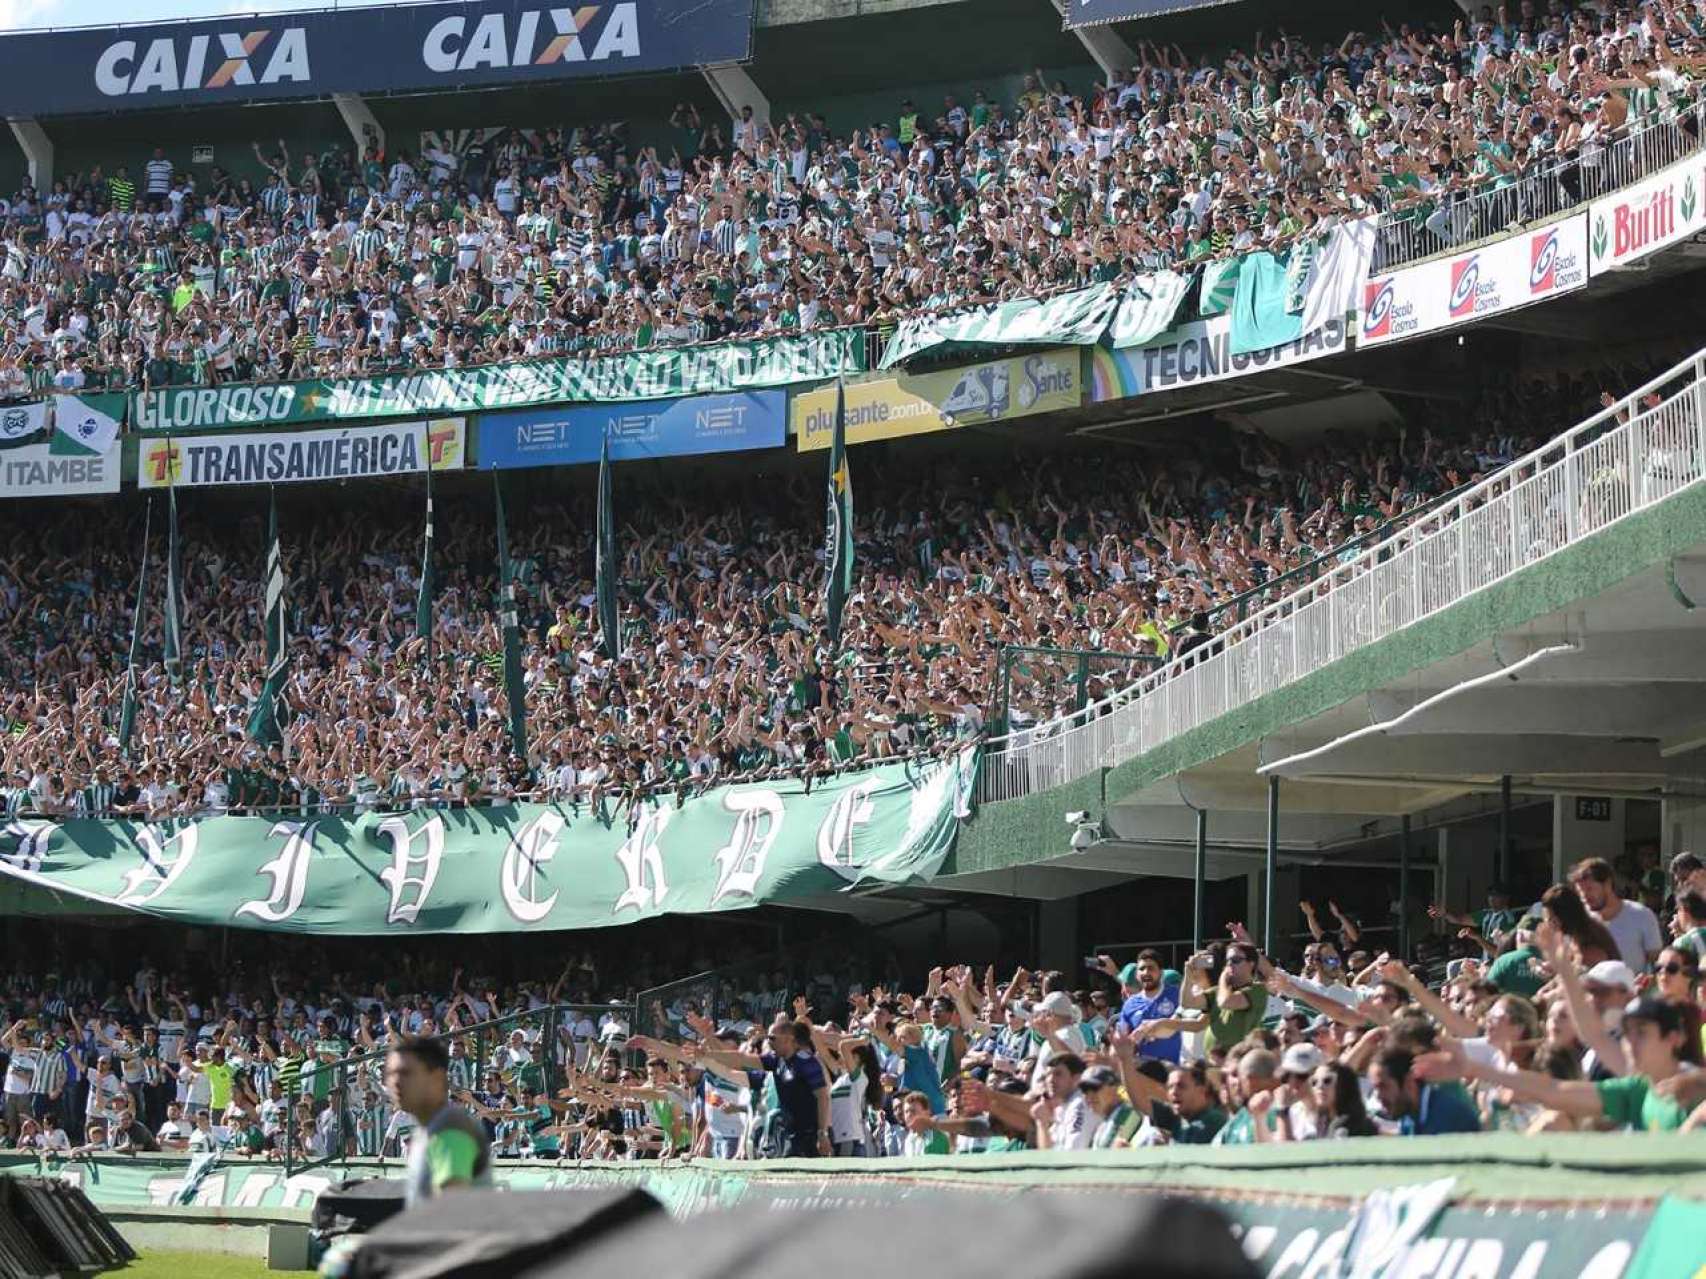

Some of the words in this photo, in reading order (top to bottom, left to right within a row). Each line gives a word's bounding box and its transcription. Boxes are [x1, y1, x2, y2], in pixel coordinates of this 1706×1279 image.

[422, 2, 641, 71] CAIXA
[95, 28, 310, 95] CAIXA
[1555, 255, 1576, 271] Escola
[1555, 270, 1582, 288] Cosmos
[1391, 301, 1414, 317] Escola
[1391, 317, 1419, 334] Cosmos
[137, 385, 296, 429] GLORIOSO
[696, 406, 748, 429] NET
[517, 421, 571, 444] NET
[607, 414, 658, 436] NET
[187, 431, 418, 483] TRANSAMÉRICA
